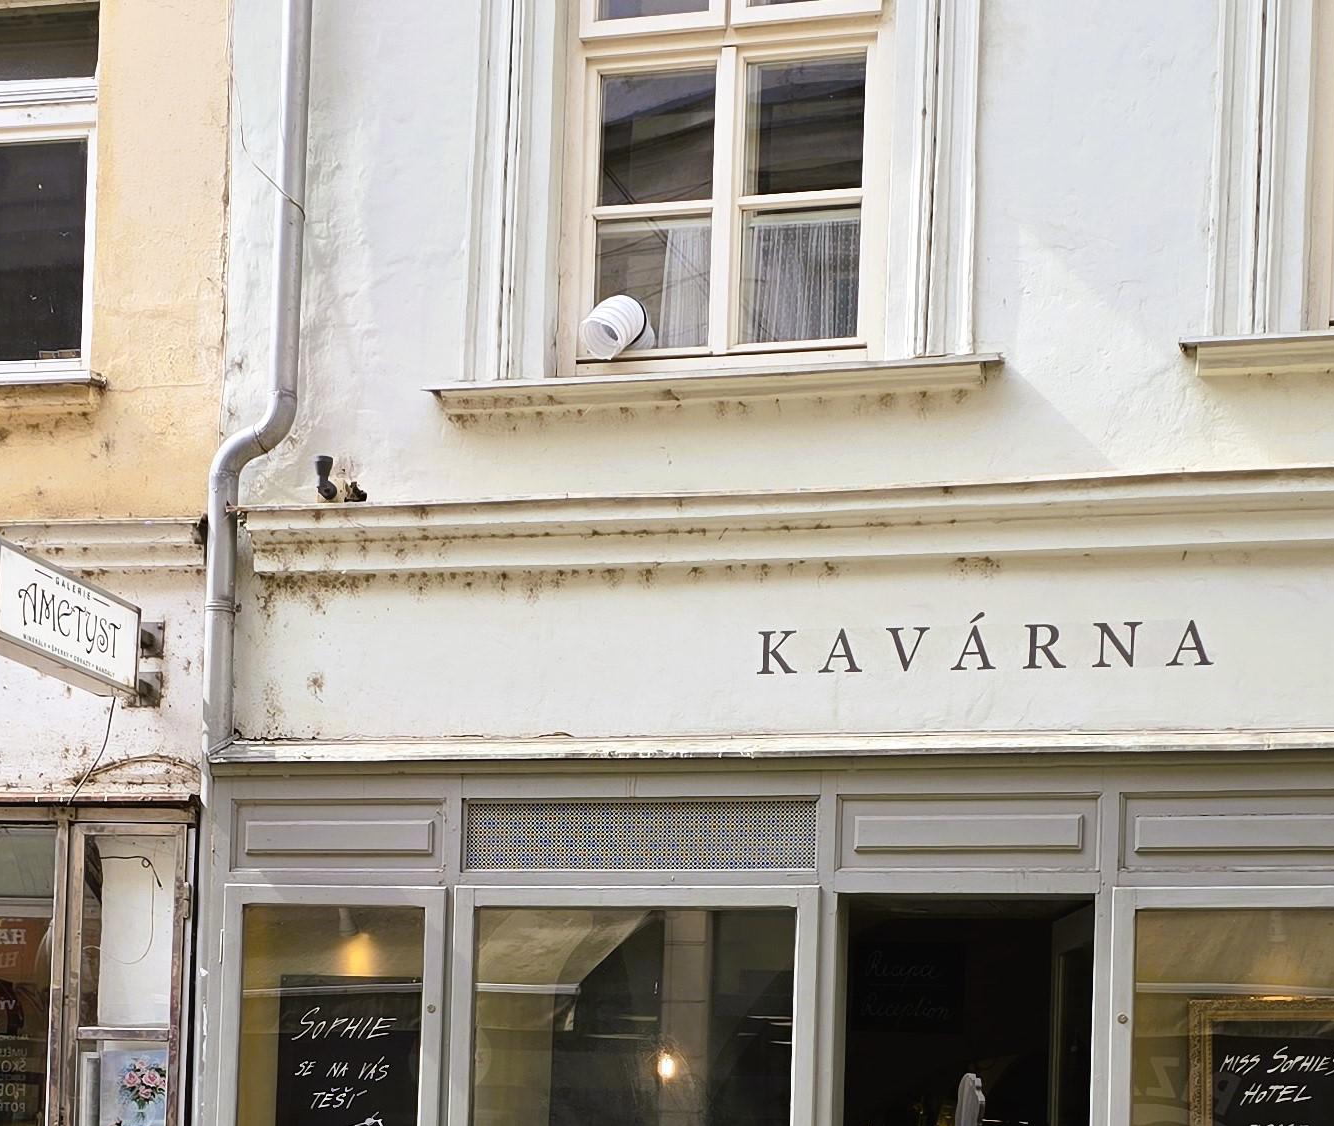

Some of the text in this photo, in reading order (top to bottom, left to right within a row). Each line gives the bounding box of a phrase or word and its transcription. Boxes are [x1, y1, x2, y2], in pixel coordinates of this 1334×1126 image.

[55, 577, 91, 600] GALERIE
[18, 583, 121, 658] AMETYST
[757, 611, 1214, 674] KAVÁRNA
[291, 1006, 398, 1041] SOPHIE
[294, 1056, 390, 1081] SE NA VÁS
[1219, 1053, 1261, 1075] MISS
[310, 1087, 367, 1109] TĚŠÍ
[1239, 1083, 1313, 1106] HOTEL
